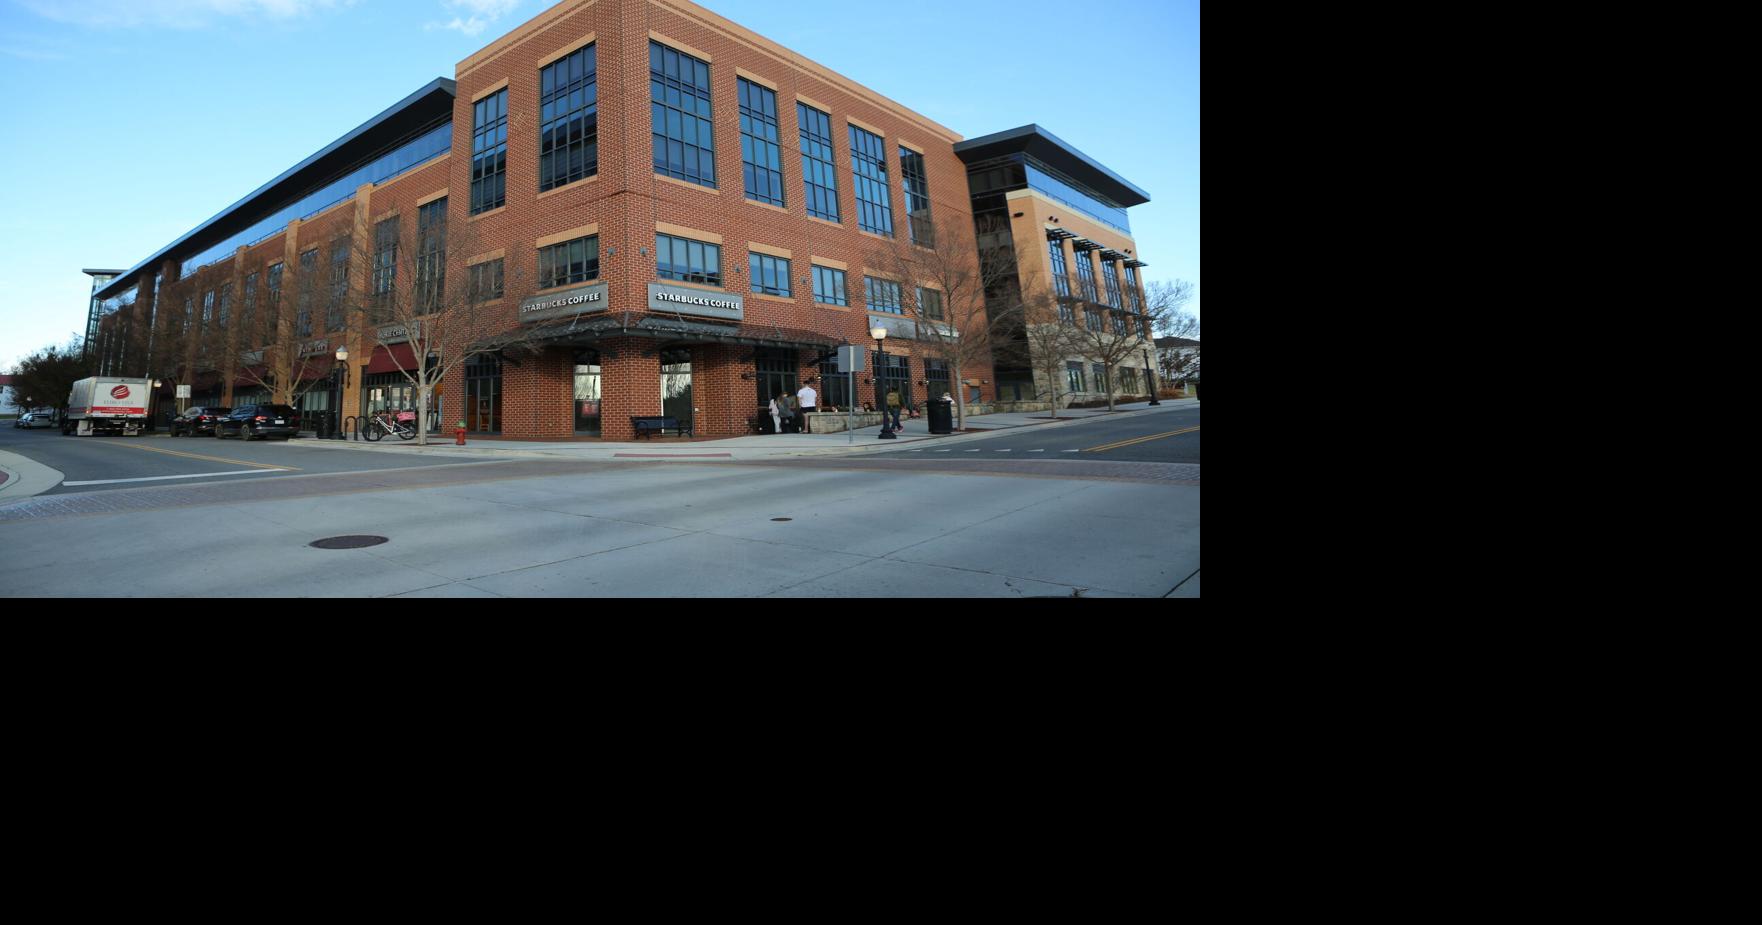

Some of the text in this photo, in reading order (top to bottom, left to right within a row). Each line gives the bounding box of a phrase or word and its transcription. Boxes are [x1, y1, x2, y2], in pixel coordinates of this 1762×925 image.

[522, 292, 600, 313] STARBUCKS COFFEE
[656, 292, 740, 310] STARBUCKS COFFEE
